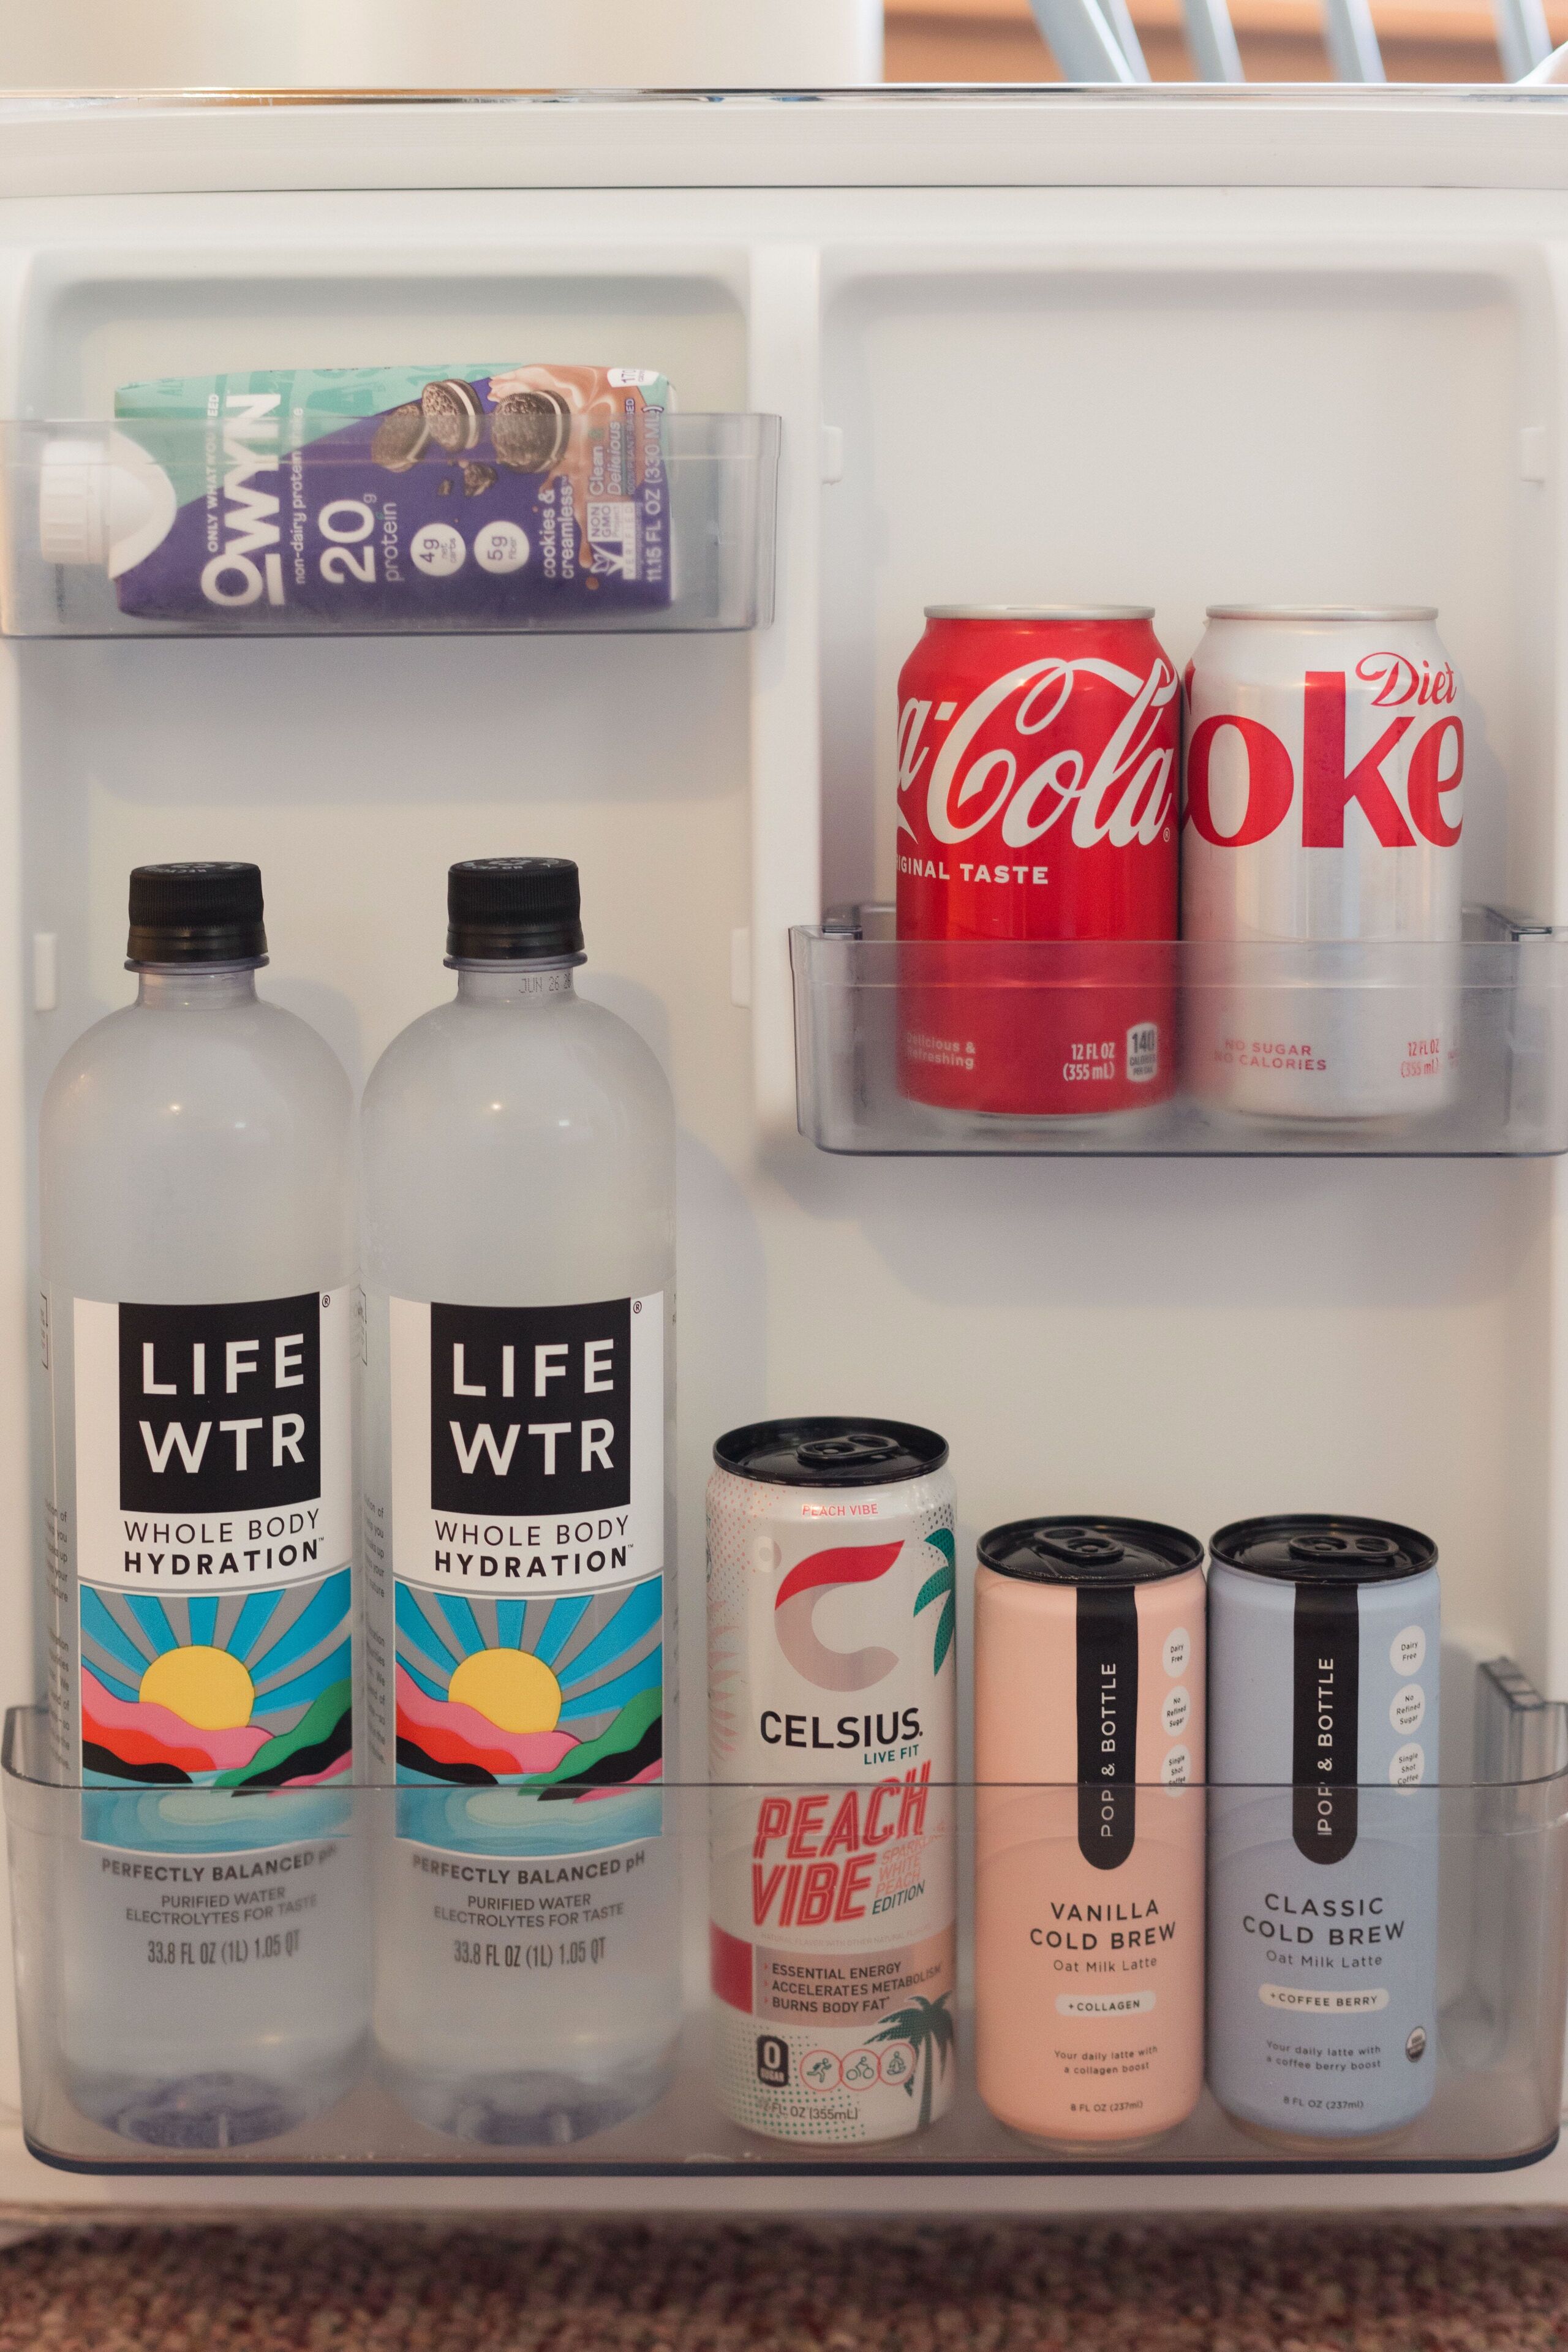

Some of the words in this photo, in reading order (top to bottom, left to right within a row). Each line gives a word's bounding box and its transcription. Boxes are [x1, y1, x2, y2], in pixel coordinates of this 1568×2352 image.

[607, 421, 622, 496] Delicious
[291, 451, 307, 510] protein
[589, 445, 605, 496] Clean
[206, 466, 219, 510] WHAT
[538, 489, 556, 504] &
[200, 394, 285, 606] OWYN
[645, 489, 661, 516] OZ
[207, 514, 219, 552] ONLY
[590, 506, 601, 537] NON
[601, 505, 611, 538] GMO
[646, 521, 662, 541] FL
[290, 512, 307, 584] non-dairy
[381, 502, 405, 582] protein
[419, 538, 440, 564] 4g
[488, 535, 508, 561] 5g
[508, 537, 518, 560] fiber
[538, 508, 557, 578] cookies
[625, 507, 634, 575] VERIFIED
[646, 546, 662, 582] 11.15
[1355, 652, 1457, 707] Diet
[1185, 669, 1464, 848] oke
[960, 863, 1049, 884] TASTE
[518, 976, 542, 993] JUN
[965, 1041, 976, 1054] &
[1071, 1043, 1084, 1060] 12
[1086, 1043, 1099, 1060] FL
[1101, 1042, 1115, 1059] OZ
[1132, 1030, 1156, 1054] 140
[1224, 1039, 1246, 1051] NO
[1252, 1042, 1312, 1056] SUGAR
[1408, 1041, 1417, 1057] 12
[1063, 1063, 1090, 1082] (355
[1092, 1061, 1115, 1080] mL)
[1239, 1054, 1327, 1071] CALORIES
[142, 1333, 304, 1395] LIFE
[453, 1338, 614, 1397] LIFE
[138, 1412, 306, 1474] WTR
[449, 1418, 615, 1476] WTR
[802, 1504, 846, 1517] PEACH
[850, 1503, 879, 1516] VIBE
[124, 1520, 233, 1544] WHOLE
[248, 1508, 319, 1540] BODY
[434, 1520, 541, 1547] WHOLE
[557, 1515, 628, 1544] BODY
[1170, 1643, 1184, 1654] Dairy
[1401, 1642, 1419, 1652] Dairy
[1402, 1653, 1417, 1662] Free
[1171, 1654, 1183, 1664] Free
[1101, 1663, 1117, 1752] BOTTLE
[1166, 1705, 1187, 1717] Refined
[1317, 1658, 1334, 1747] BOTTLE
[1396, 1702, 1421, 1715] Refined
[1169, 1717, 1184, 1728] Sugar
[1399, 1714, 1419, 1725] Sugar
[864, 1749, 896, 1765] LIVE
[900, 1744, 919, 1760] FIT
[1168, 1755, 1185, 1766] Single
[1317, 1757, 1333, 1771] &
[1398, 1752, 1419, 1764] Single
[1101, 1762, 1115, 1776] &
[1170, 1766, 1183, 1776] Shot
[1397, 1774, 1419, 1786] Coffee
[1401, 1764, 1416, 1774] Shot
[752, 1759, 932, 1860] PEACH
[1101, 1789, 1115, 1838] POP
[101, 1856, 205, 1882] PERFECTLY
[212, 1851, 314, 1881] BALANCED
[412, 1853, 511, 1885] PERFECTLY
[518, 1859, 620, 1885] BALANCED
[625, 1850, 646, 1873] pH
[161, 1894, 229, 1908] PURIFIED
[233, 1886, 285, 1906] WATER
[467, 1895, 535, 1911] PURIFIED
[539, 1893, 591, 1909] WATER
[751, 1853, 878, 1929] VIBE
[872, 1879, 925, 1915] EDITION
[126, 1908, 239, 1926] ELECTROLYTES
[244, 1907, 273, 1922] FOR
[277, 1894, 317, 1916] TASTE
[434, 1905, 545, 1928] ELECTROLYTES
[549, 1912, 578, 1927] FOR
[582, 1902, 624, 1923] TASTE
[1050, 1899, 1159, 1922] VANILLA
[1264, 1893, 1384, 1917] CLASSIC
[1030, 1928, 1098, 1950] COLD
[1111, 1921, 1176, 1950] BREW
[1242, 1915, 1314, 1944] COLD
[1329, 1920, 1405, 1946] BREW
[148, 1940, 175, 1965] 33.8
[181, 1942, 195, 1964] FL
[200, 1942, 216, 1964] OZ
[221, 1939, 248, 1966] (1L)
[255, 1934, 281, 1959] 1.05
[285, 1928, 301, 1957] QT
[453, 1939, 481, 1965] 33.8
[486, 1944, 500, 1967] FL
[505, 1945, 521, 1967] OZ
[526, 1943, 553, 1969] (1L)
[559, 1940, 586, 1965] 1.05
[590, 1936, 607, 1964] QT
[772, 1962, 845, 1980] ESSENTIAL
[850, 1961, 902, 1979] ENERGY
[1053, 1959, 1079, 1972] Oat
[1086, 1961, 1115, 1973] Milk
[1122, 1957, 1158, 1972] Latte
[1265, 1950, 1293, 1966] Oat
[1301, 1954, 1334, 1969] Milk
[1341, 1955, 1382, 1969] Latte
[771, 1980, 869, 1996] ACCELERATES
[772, 1997, 818, 2013] BURNS
[823, 2000, 858, 2013] BODY
[1336, 1995, 1378, 2007] BERRY
[763, 2041, 781, 2070] 0
[1054, 2050, 1077, 2061] Your
[1082, 2051, 1107, 2062] daily
[1111, 2049, 1134, 2060] latte
[1137, 2045, 1158, 2057] with
[1266, 2040, 1290, 2052] Your
[1294, 2046, 1322, 2057] daily
[1327, 2047, 1354, 2057] latte
[1357, 2045, 1381, 2055] with
[1074, 2065, 1118, 2076] collagen
[1122, 2061, 1150, 2073] boost
[1275, 2056, 1311, 2070] coffee
[1315, 2060, 1346, 2072] berry
[1351, 2059, 1381, 2071] boost
[790, 2105, 805, 2118] OZ
[809, 2106, 859, 2120] (355mL)
[1070, 2103, 1076, 2112] 8
[1079, 2103, 1090, 2112] FL
[1093, 2103, 1107, 2112] OZ
[1109, 2100, 1144, 2113] (237ml)
[1291, 2097, 1303, 2107] FL
[1308, 2100, 1323, 2109] OZ
[1325, 2099, 1364, 2110] (237ml)
